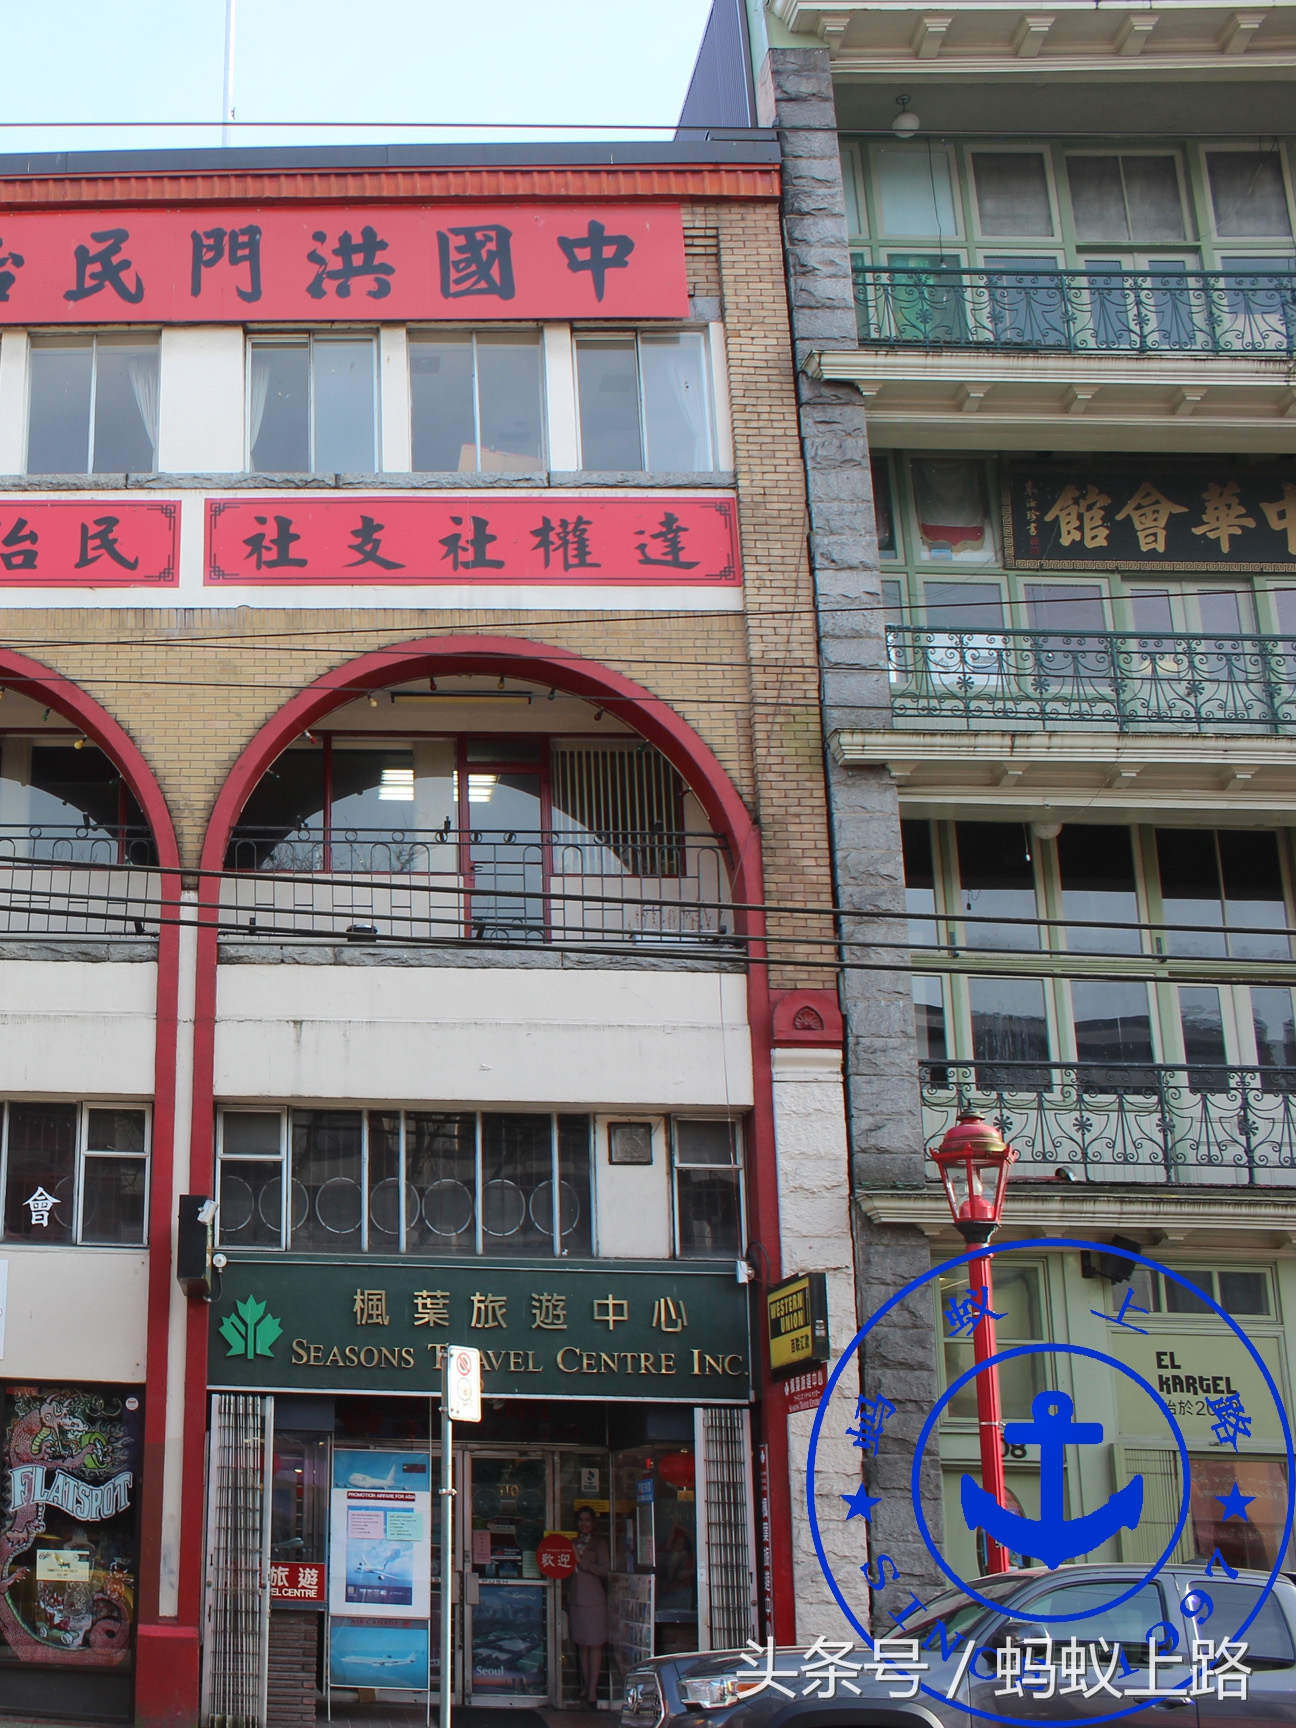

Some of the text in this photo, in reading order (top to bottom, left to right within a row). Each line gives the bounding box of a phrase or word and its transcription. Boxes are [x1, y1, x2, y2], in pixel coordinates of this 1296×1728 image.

[353, 1287, 687, 1332] 楓葉旅遊中心
[770, 1291, 803, 1320] WESTERN
[780, 1308, 805, 1334] UNION
[291, 1337, 749, 1378] SEASONS TAVEL CENTRE INC.
[1155, 1351, 1181, 1369] EL
[9, 1464, 133, 1522] FLATSPOT
[541, 1553, 572, 1569] 歡迎
[282, 1588, 317, 1598] CENTRE
[476, 1665, 504, 1676] Seoul
